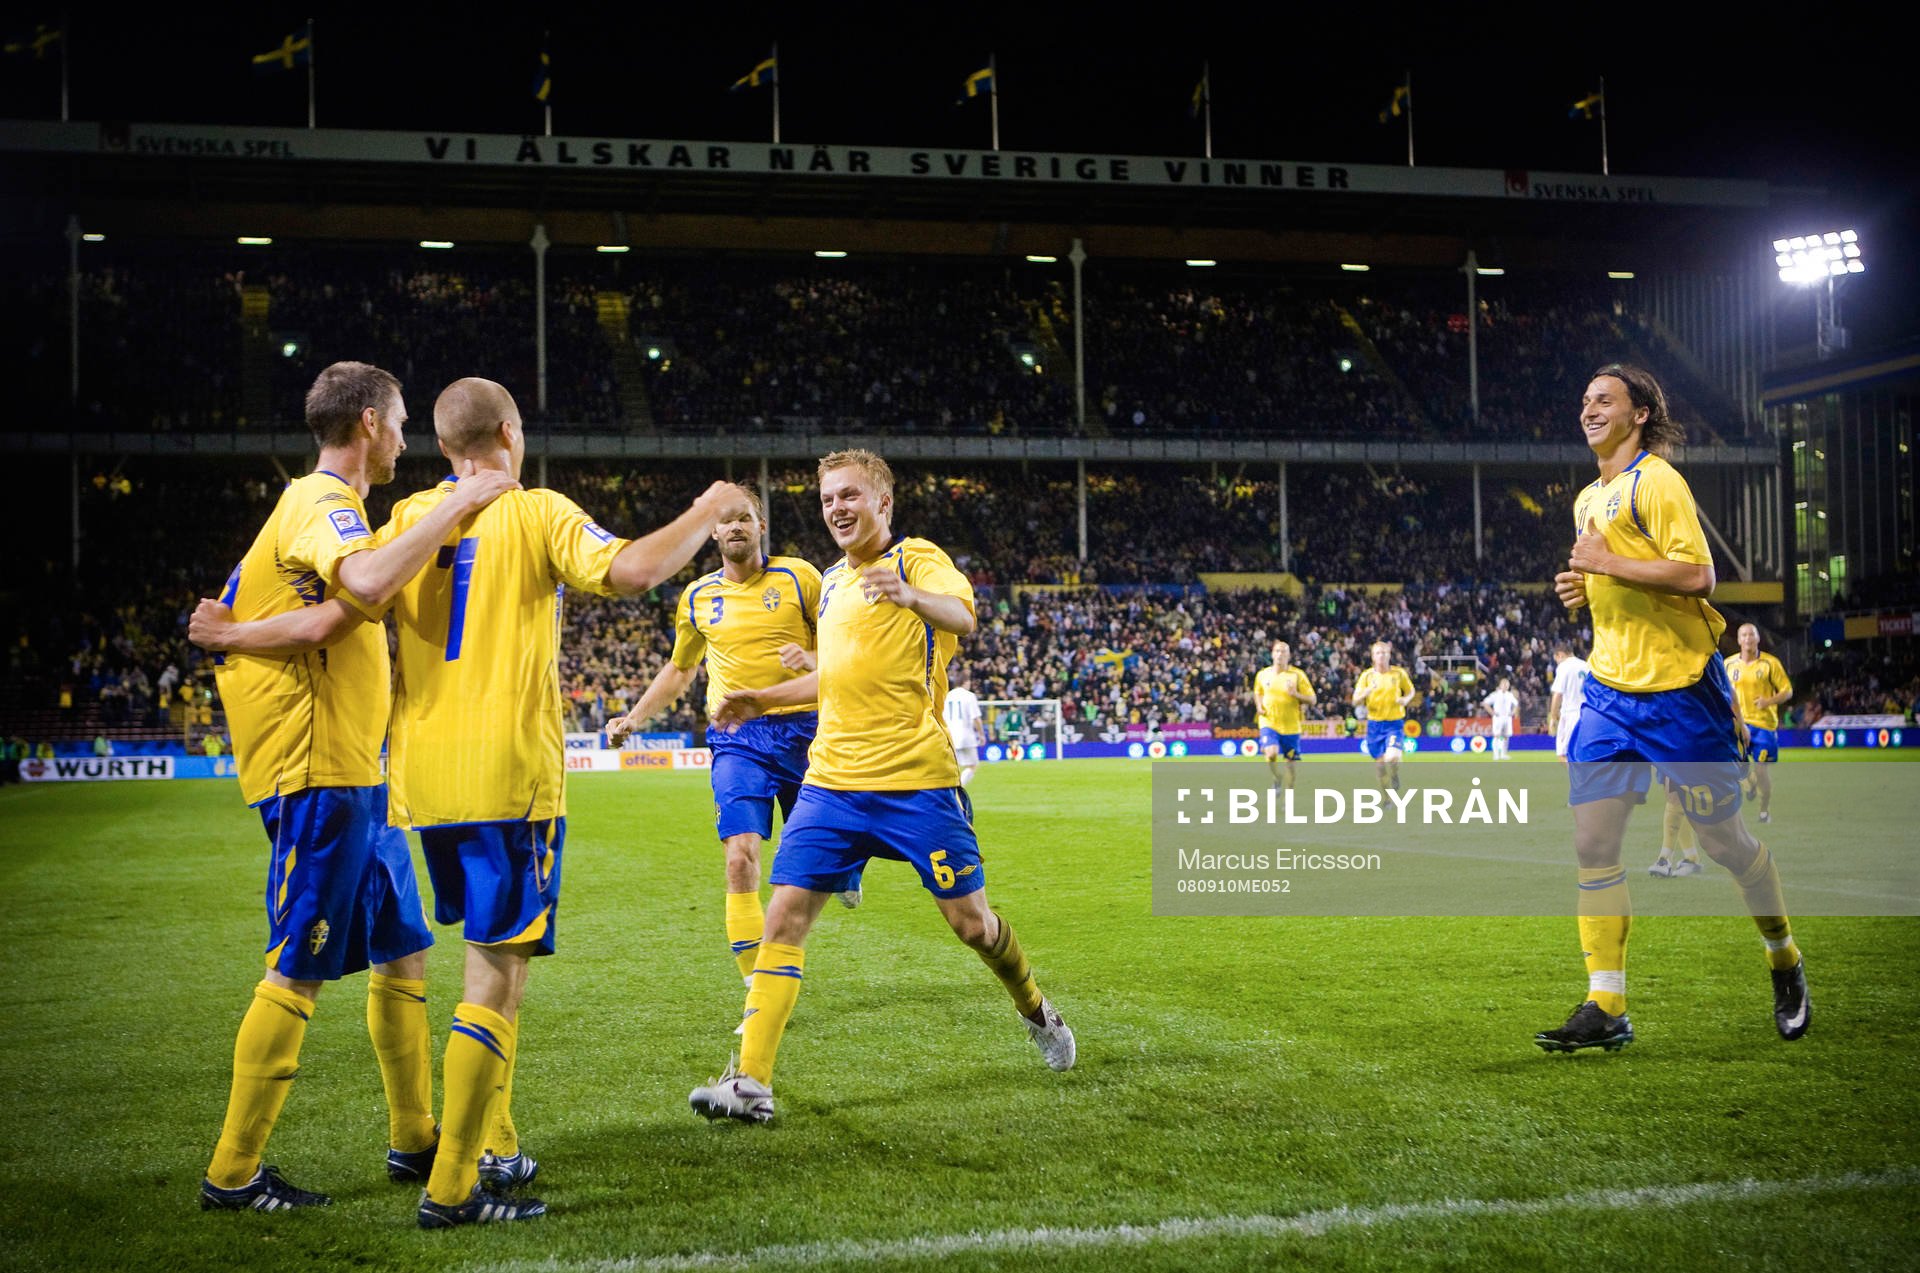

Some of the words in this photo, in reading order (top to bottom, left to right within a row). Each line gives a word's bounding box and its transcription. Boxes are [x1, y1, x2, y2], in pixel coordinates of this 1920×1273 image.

[136, 136, 235, 156] SVENSKA
[244, 139, 294, 160] SPEL
[425, 136, 475, 160] VI
[516, 134, 729, 169] ÄLSKAR
[768, 144, 870, 172] NÄR
[911, 152, 1129, 181] SVERIGE
[1164, 160, 1348, 189] VINNER
[1534, 183, 1611, 200] SVENSKA
[1616, 186, 1657, 201] SPEL
[709, 596, 725, 625] 3
[1213, 726, 1260, 739] Swedba
[1454, 718, 1493, 738] Estre
[54, 758, 167, 778] WÜRTH
[625, 753, 668, 767] office
[1680, 784, 1714, 817] 10
[929, 850, 956, 890] 6
